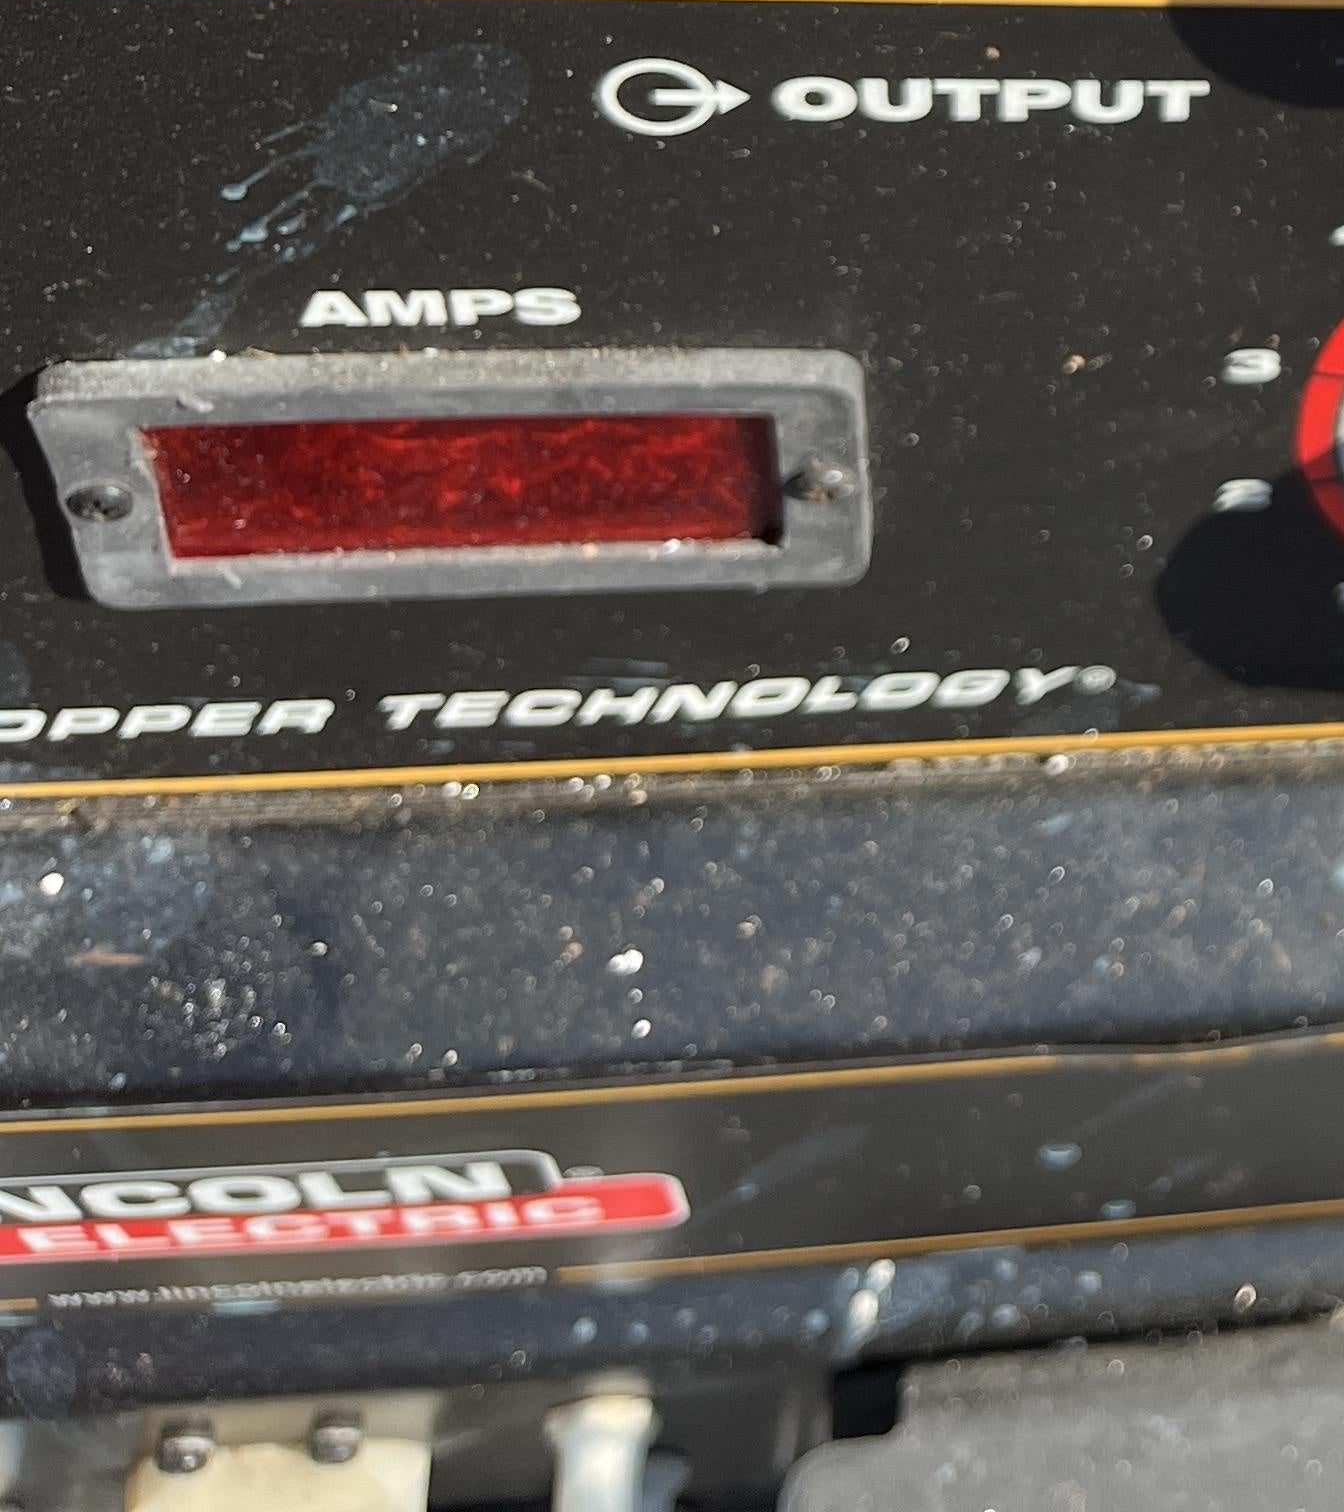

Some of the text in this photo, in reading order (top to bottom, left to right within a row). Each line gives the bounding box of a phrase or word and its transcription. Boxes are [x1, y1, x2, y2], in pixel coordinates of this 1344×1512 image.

[772, 75, 1211, 124] OUTPUT
[298, 288, 583, 328] AMPS
[1223, 348, 1281, 384] 3
[17, 1196, 606, 1252] ELECTRIC
